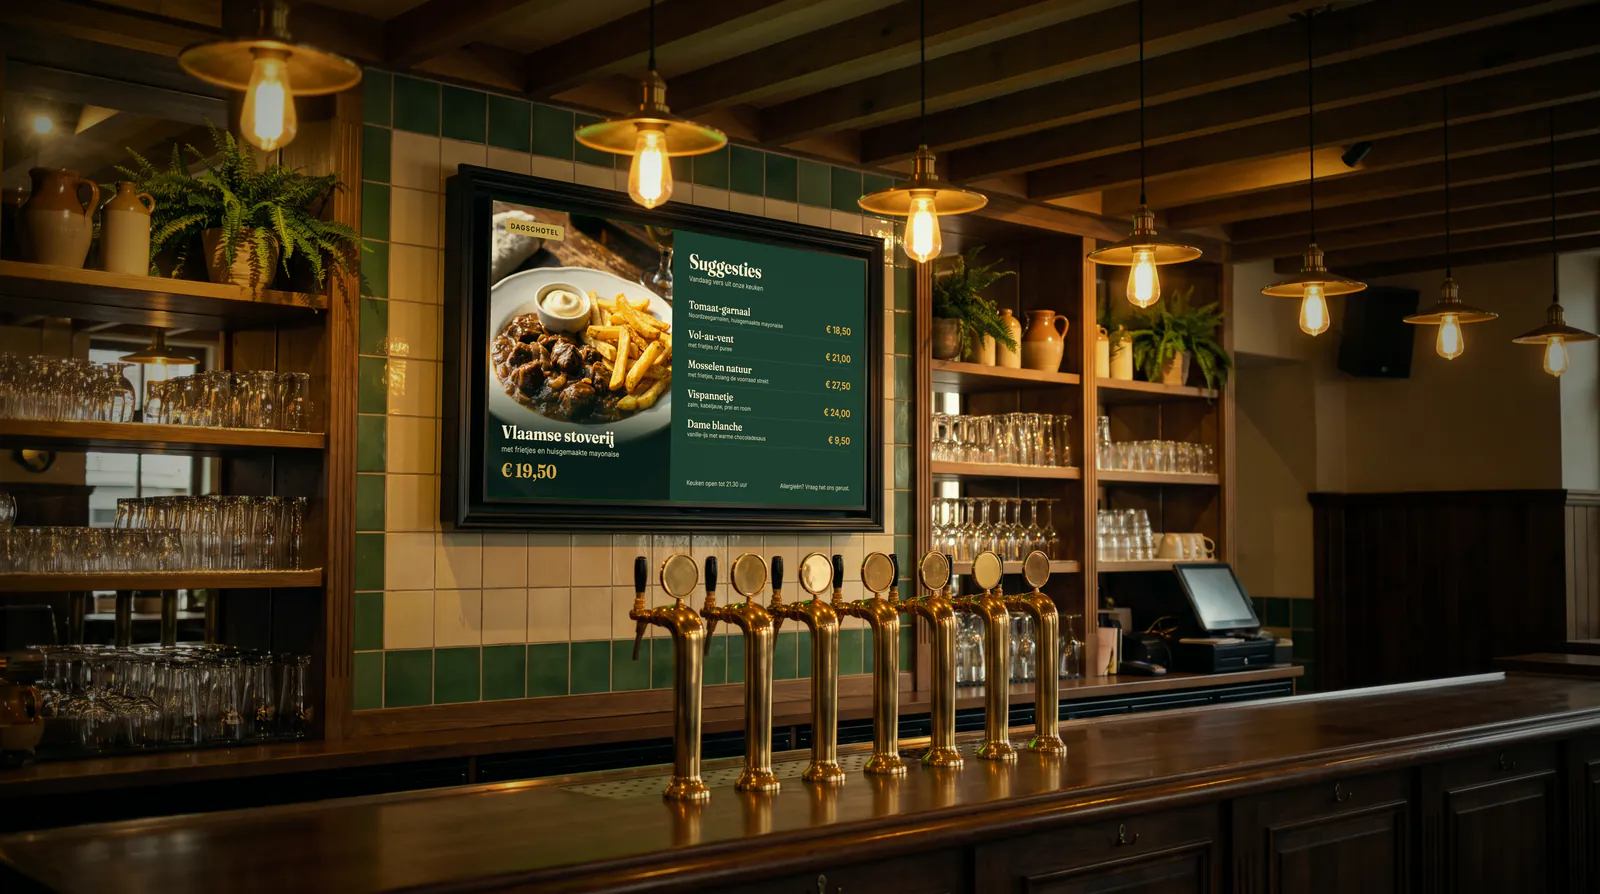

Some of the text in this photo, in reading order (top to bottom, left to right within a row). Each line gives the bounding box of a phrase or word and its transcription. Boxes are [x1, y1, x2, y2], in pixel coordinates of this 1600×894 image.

[510, 222, 558, 236] DAGSCHOTEL
[689, 254, 762, 279] Suggesties
[689, 276, 711, 285] Vandaag
[688, 300, 751, 317] Tomaat-garnaal
[731, 317, 760, 326] huisgemaakte
[688, 330, 734, 343] Vol-au-vent
[826, 325, 851, 336] € 18,50
[826, 353, 851, 364] € 21,00
[688, 360, 752, 374] Mosselen natuur
[826, 381, 850, 391] € 27,50
[688, 390, 734, 403] Vispannetje
[824, 408, 850, 418] € 24,00
[687, 419, 742, 432] Dame blanche
[502, 425, 614, 448] Vlaamse stoverij
[828, 436, 850, 446] € 9,50
[515, 446, 536, 455] frietjes
[547, 448, 588, 457] huisgemaakte
[501, 462, 557, 482] € 19,50
